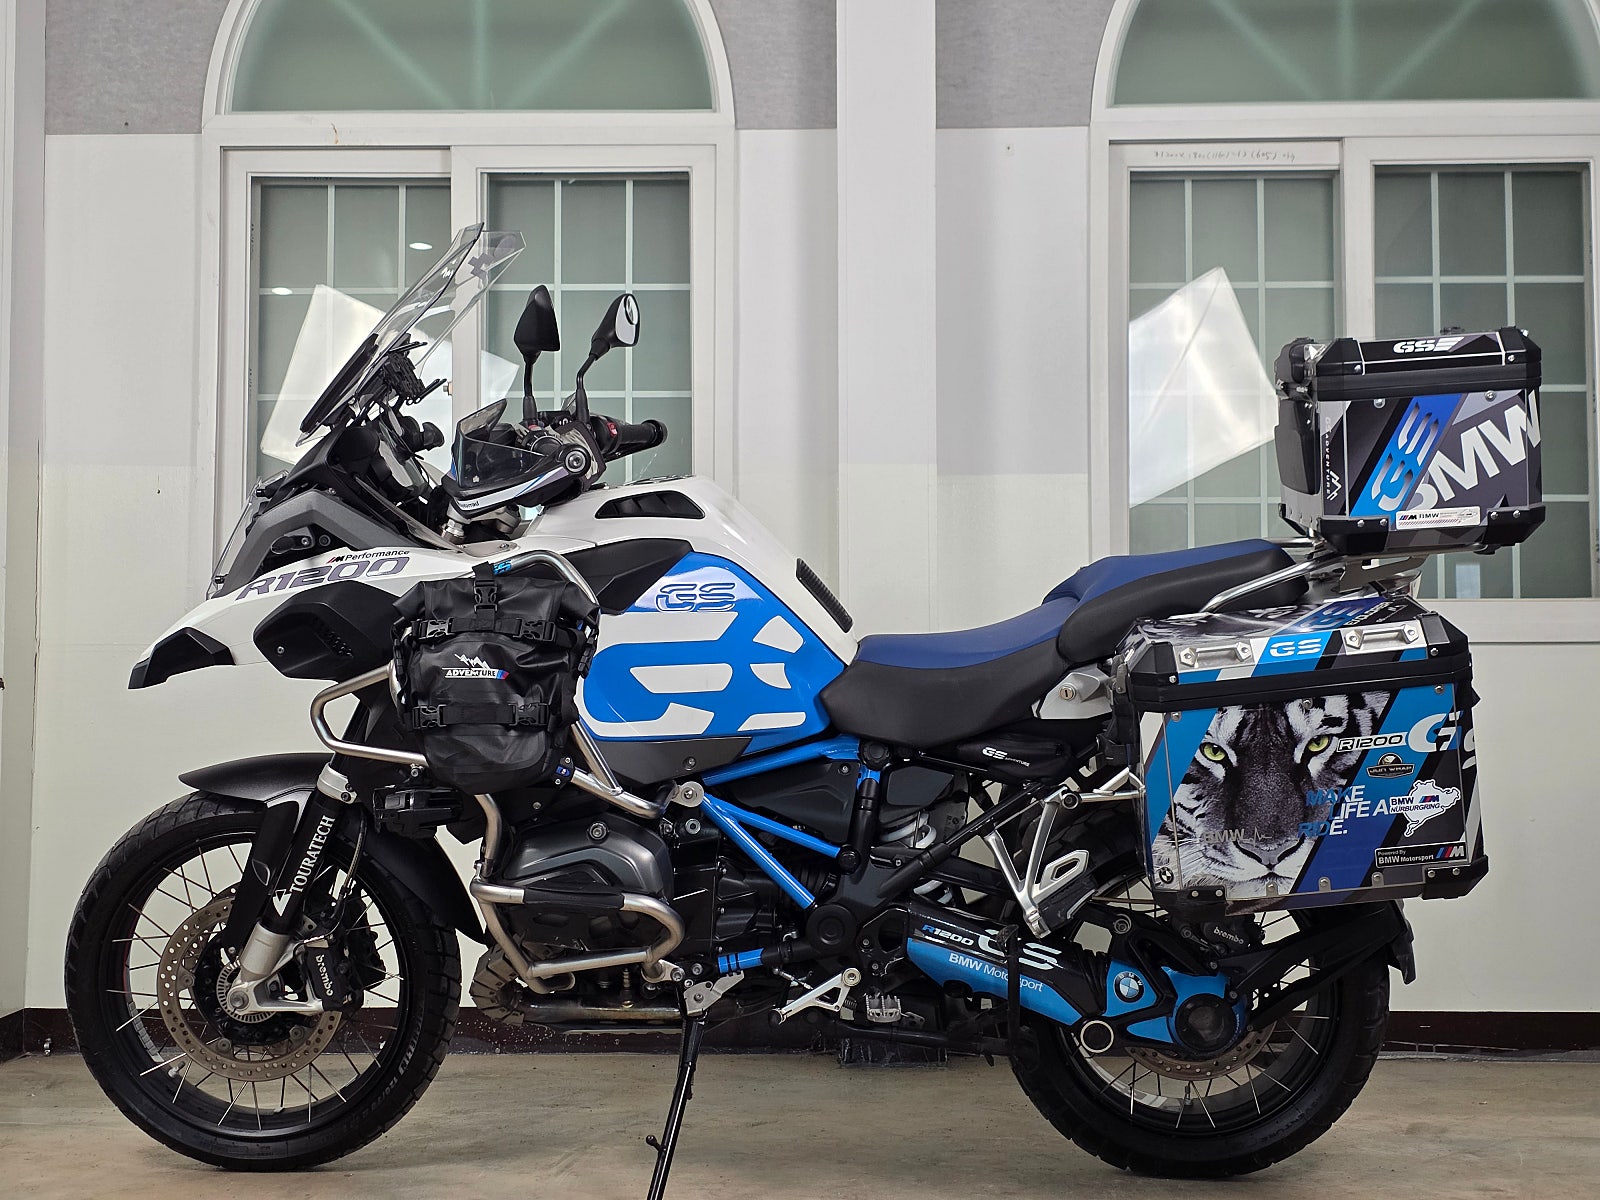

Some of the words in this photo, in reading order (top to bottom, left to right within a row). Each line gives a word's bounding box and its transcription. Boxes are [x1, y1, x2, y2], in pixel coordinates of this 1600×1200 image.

[345, 550, 411, 562] Performance
[235, 556, 411, 601] R1200
[656, 582, 736, 612] GS
[1269, 638, 1322, 657] GS
[446, 669, 496, 677] ADVENTURE
[1337, 734, 1404, 751] R1200
[982, 747, 1008, 760] GS
[1306, 785, 1366, 806] MAKE
[1391, 797, 1415, 806] BMW
[1328, 801, 1371, 821] LIFE
[1372, 799, 1389, 816] A
[1202, 829, 1245, 843] BMW
[1298, 819, 1348, 838] RIDE.
[289, 814, 336, 893] TOURATECH
[1378, 856, 1400, 864] BMW
[1400, 854, 1434, 863] Motorsport
[922, 924, 974, 946] R1200
[1213, 926, 1244, 945] brembo
[948, 952, 983, 972] BMW
[315, 954, 334, 996] brembo
